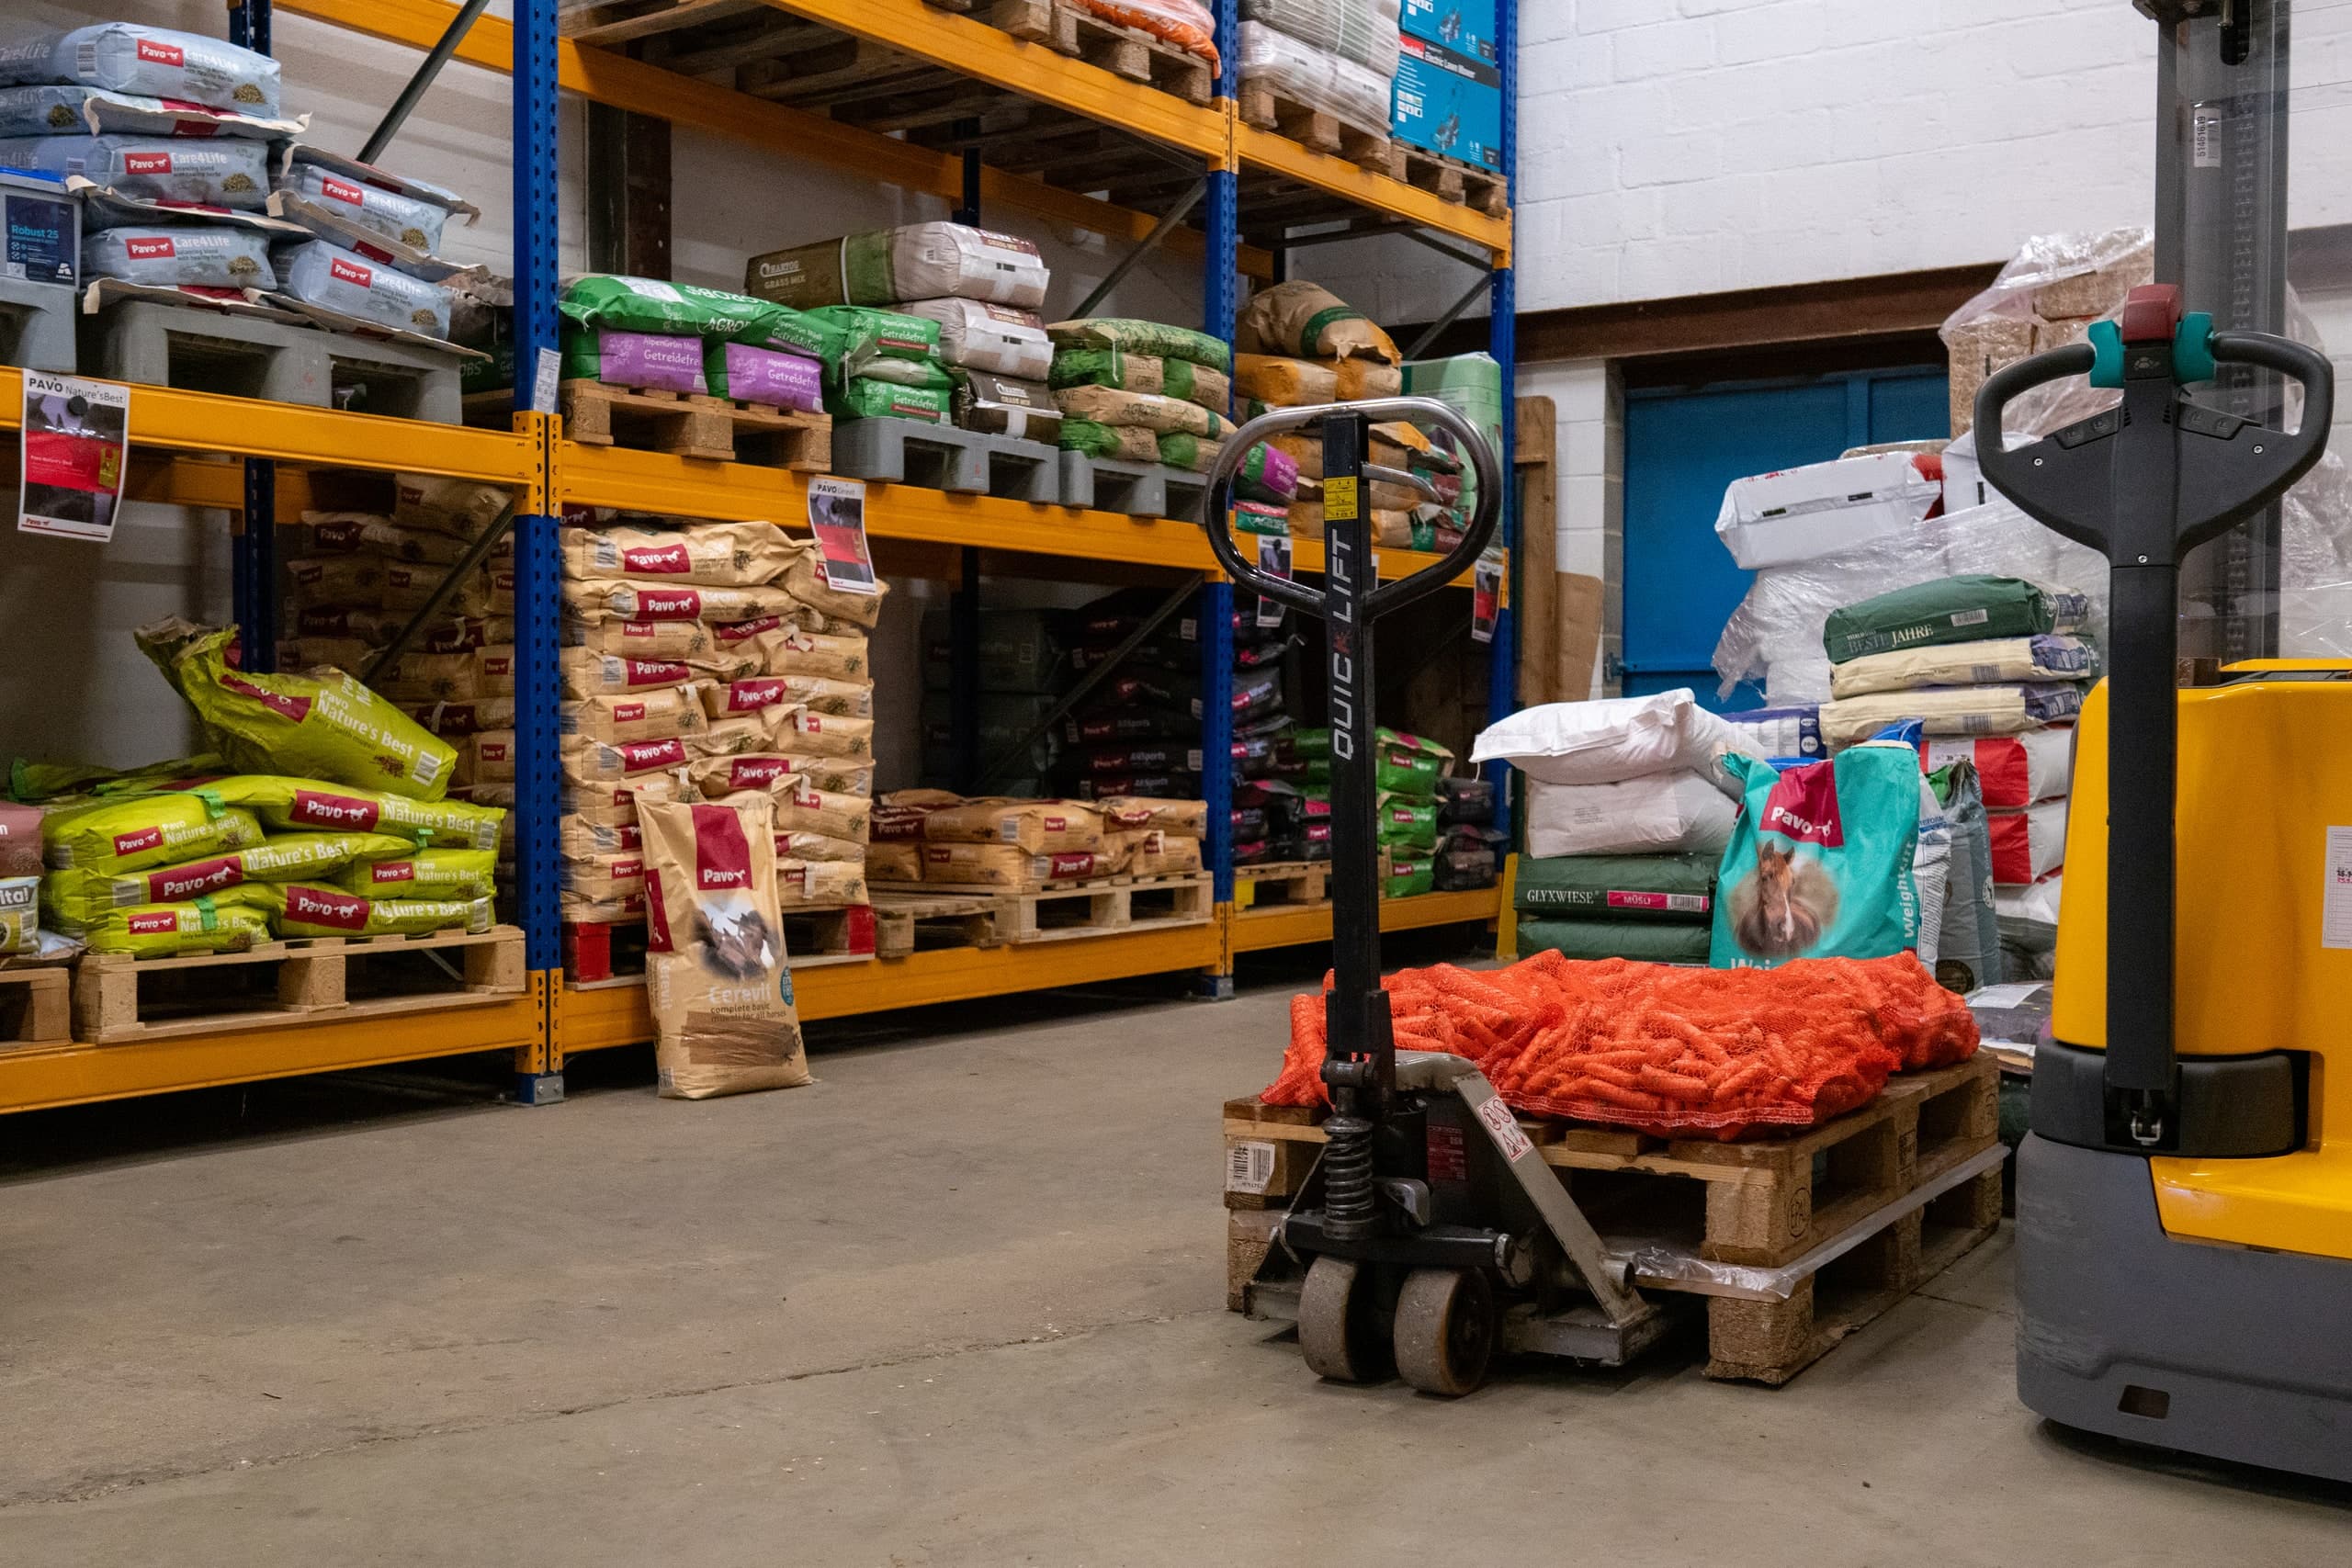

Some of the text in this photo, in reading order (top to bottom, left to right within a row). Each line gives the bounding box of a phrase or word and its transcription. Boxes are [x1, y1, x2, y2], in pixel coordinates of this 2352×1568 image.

[141, 45, 167, 59] Pavo
[130, 152, 228, 169] Pavo Care4Life
[326, 184, 348, 197] Pavo
[364, 190, 413, 215] Care4Life
[11, 224, 59, 239] Robust 25
[131, 236, 230, 254] Pavo Care4Life
[334, 264, 356, 279] Pavo
[372, 272, 423, 296] Care4Life
[704, 317, 752, 333] AGRO
[881, 329, 927, 344] Getreidefrei
[644, 349, 699, 367] Getreidefre
[28, 377, 63, 393] PAVO
[893, 394, 939, 411] Getreidefrei
[817, 483, 838, 493] PAVO
[629, 552, 661, 566] Pavo
[1331, 529, 1354, 625] LIFT
[648, 599, 675, 613] Pavo
[626, 624, 643, 634] Pavo
[1892, 624, 1934, 648] JAHRE
[636, 661, 665, 675] Pavo
[319, 689, 348, 710] Pavo
[738, 690, 761, 703] Pavo
[616, 710, 633, 719] Pavo
[317, 697, 413, 760] Nature's Best
[632, 746, 661, 761] Pavo
[738, 766, 763, 779] Pavo
[306, 800, 344, 819] Pavo
[384, 803, 475, 832] Nature's Best
[162, 819, 187, 832] Pavo
[1770, 806, 1813, 835] Pavo
[165, 824, 213, 846] Nature's
[216, 817, 240, 832] Best
[877, 823, 900, 835] Pavo
[119, 837, 144, 852] Pavo
[246, 840, 349, 871] Nature's Best
[376, 868, 398, 879] Pavo
[615, 865, 632, 875] Pavo
[1057, 861, 1078, 873] Pavo
[416, 870, 481, 882] Nature's Best
[704, 868, 734, 884] Pavo
[164, 878, 205, 897] Pavo
[1527, 888, 1596, 907] GLYXWIESE
[298, 897, 333, 916] Pavo
[373, 901, 469, 918] Nature's Best
[132, 919, 160, 931] Pavo
[708, 982, 773, 1005] Cerevit
[710, 1002, 772, 1014] complete basic
